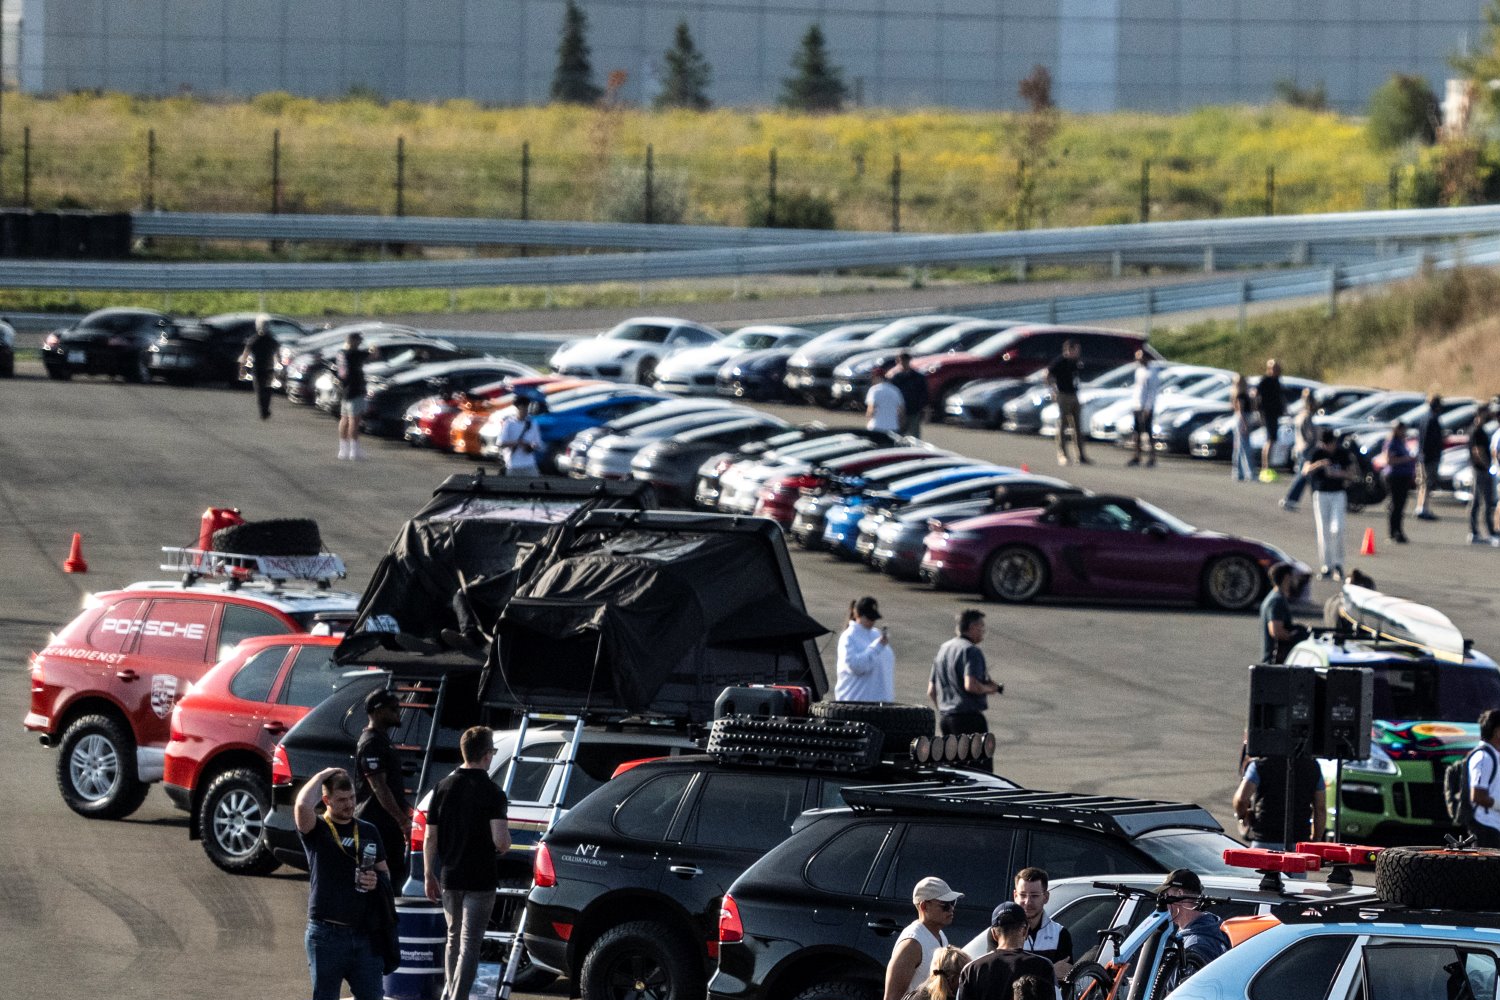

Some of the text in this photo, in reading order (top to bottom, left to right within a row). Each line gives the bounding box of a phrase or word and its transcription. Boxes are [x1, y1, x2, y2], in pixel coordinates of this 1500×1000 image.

[101, 618, 206, 640] PORSCHE
[561, 855, 608, 867] COLLISION GROUP
